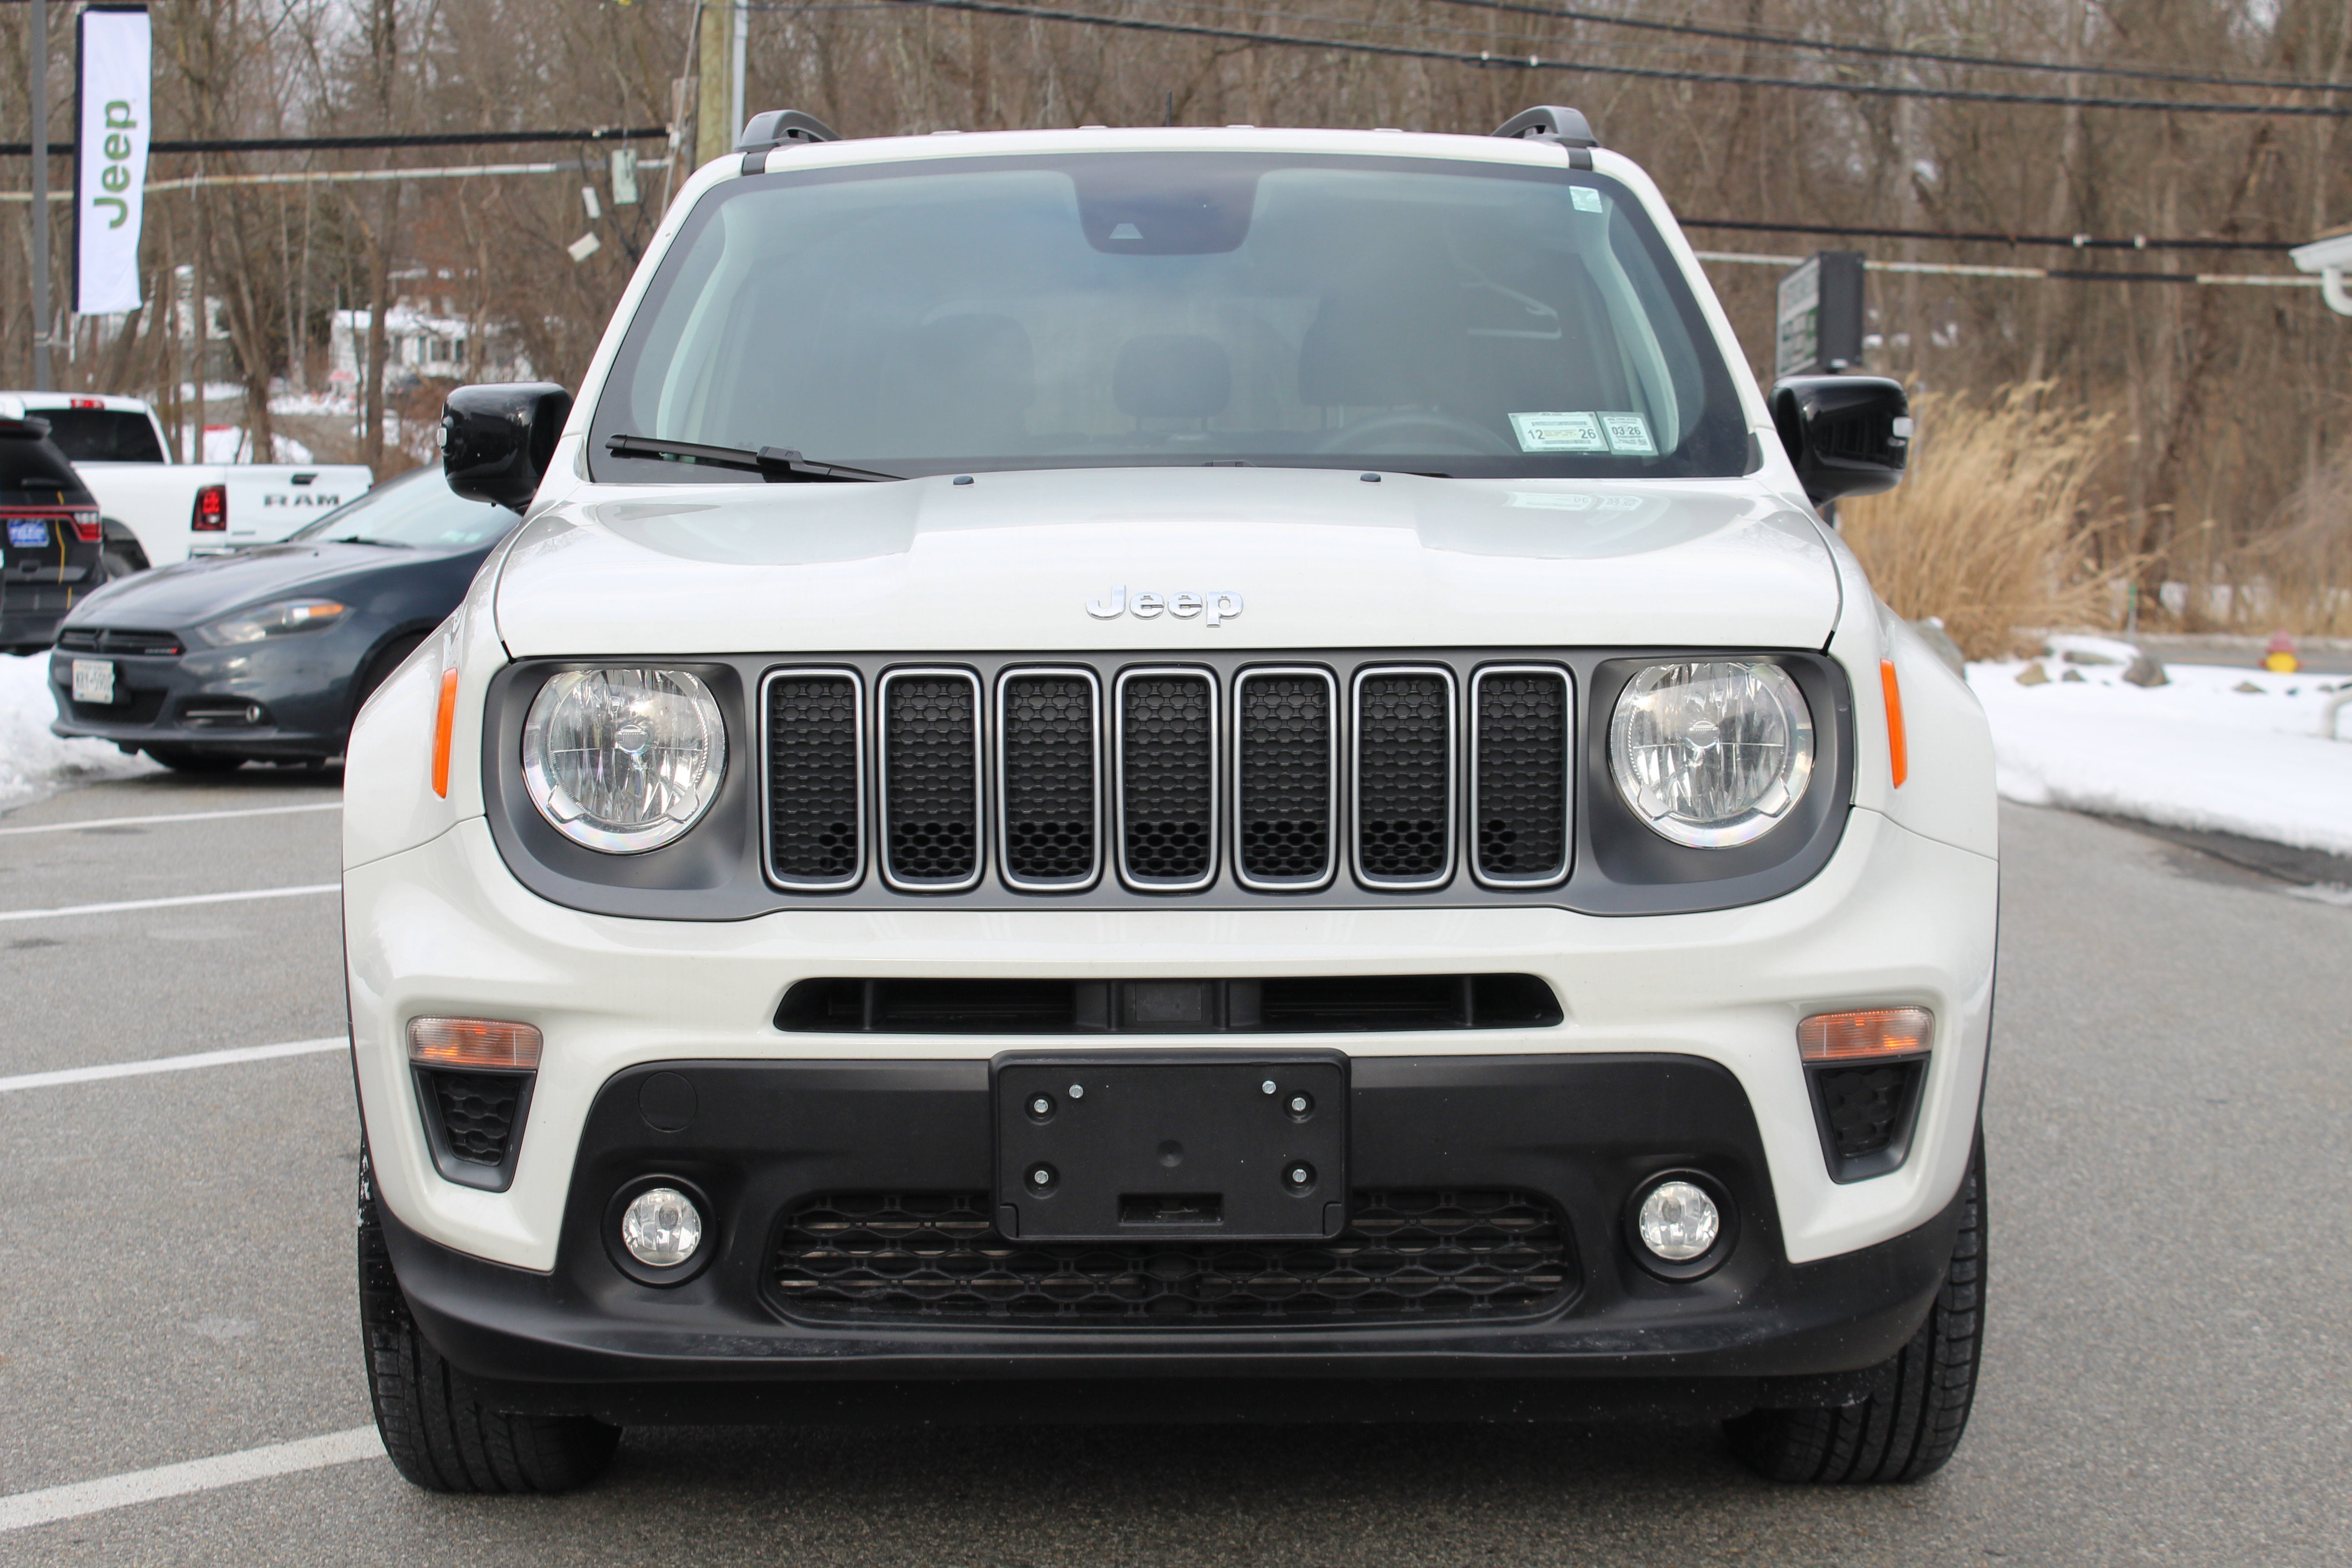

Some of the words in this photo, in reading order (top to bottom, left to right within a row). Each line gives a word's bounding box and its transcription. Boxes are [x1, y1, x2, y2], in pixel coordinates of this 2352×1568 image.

[93, 100, 137, 229] Jeep
[1528, 429, 1545, 440] 12
[1578, 429, 1596, 439] 26
[1611, 426, 1625, 435] 03
[1627, 426, 1641, 435] 26
[264, 494, 338, 505] RAM
[1086, 584, 1244, 628] Jeep
